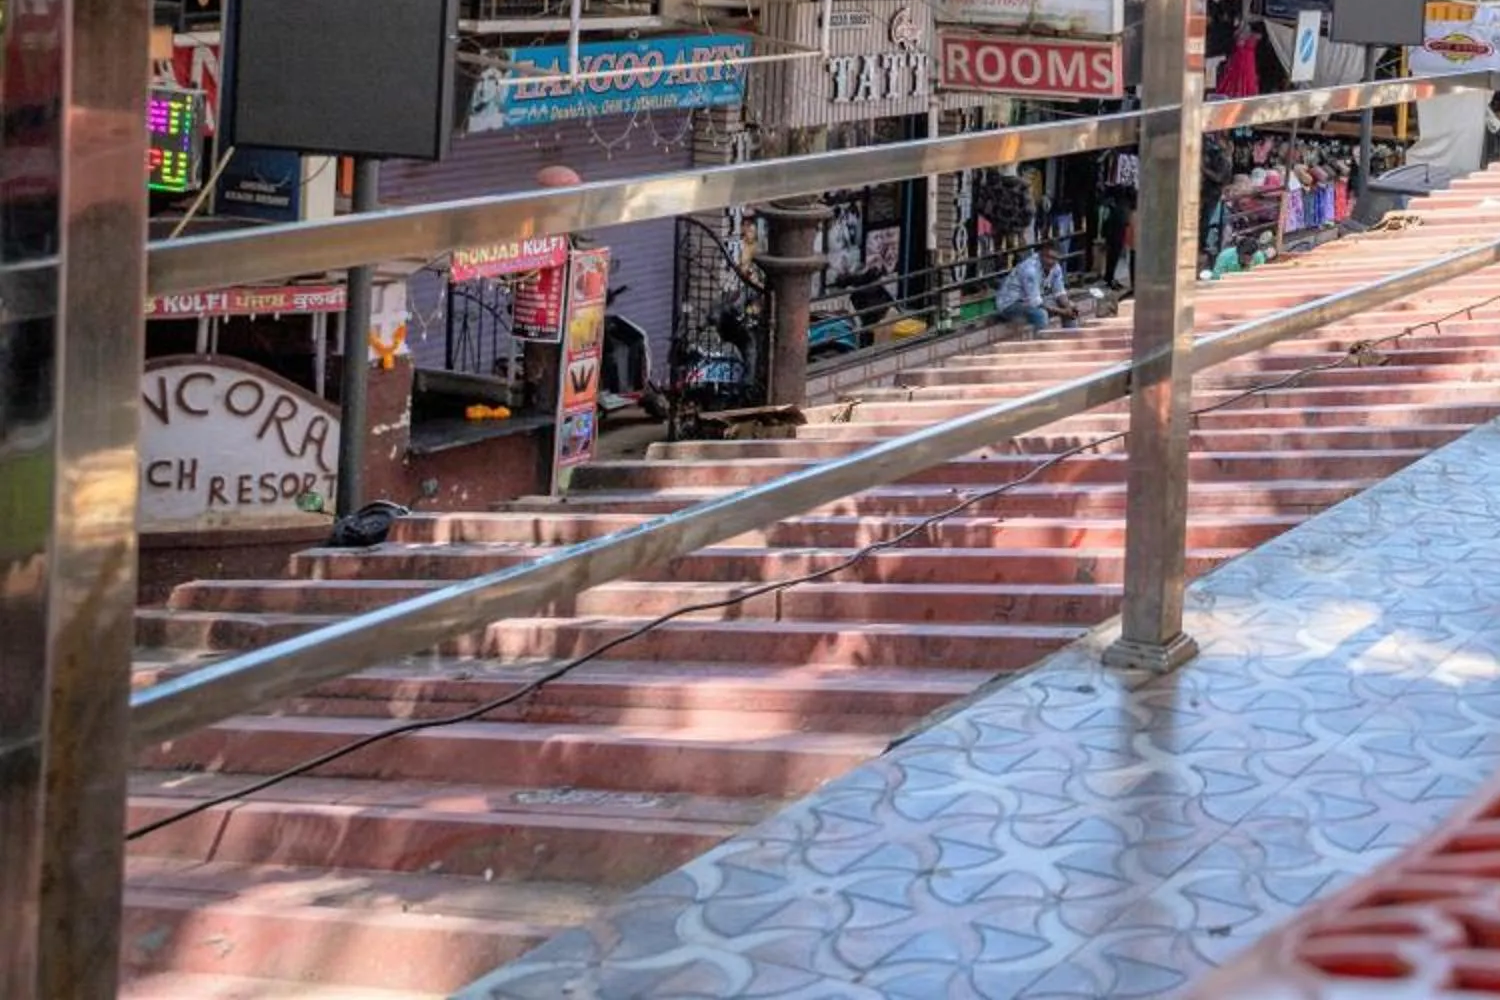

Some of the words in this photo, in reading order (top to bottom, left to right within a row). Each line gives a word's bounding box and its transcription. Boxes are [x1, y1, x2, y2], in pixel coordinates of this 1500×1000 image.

[666, 43, 746, 85] ARTS
[828, 52, 929, 102] TATT
[946, 43, 1115, 90] ROOMS
[522, 236, 565, 255] KULFI
[163, 293, 228, 312] KULFI
[142, 371, 331, 473] NCORA
[208, 472, 337, 505] RESORT
